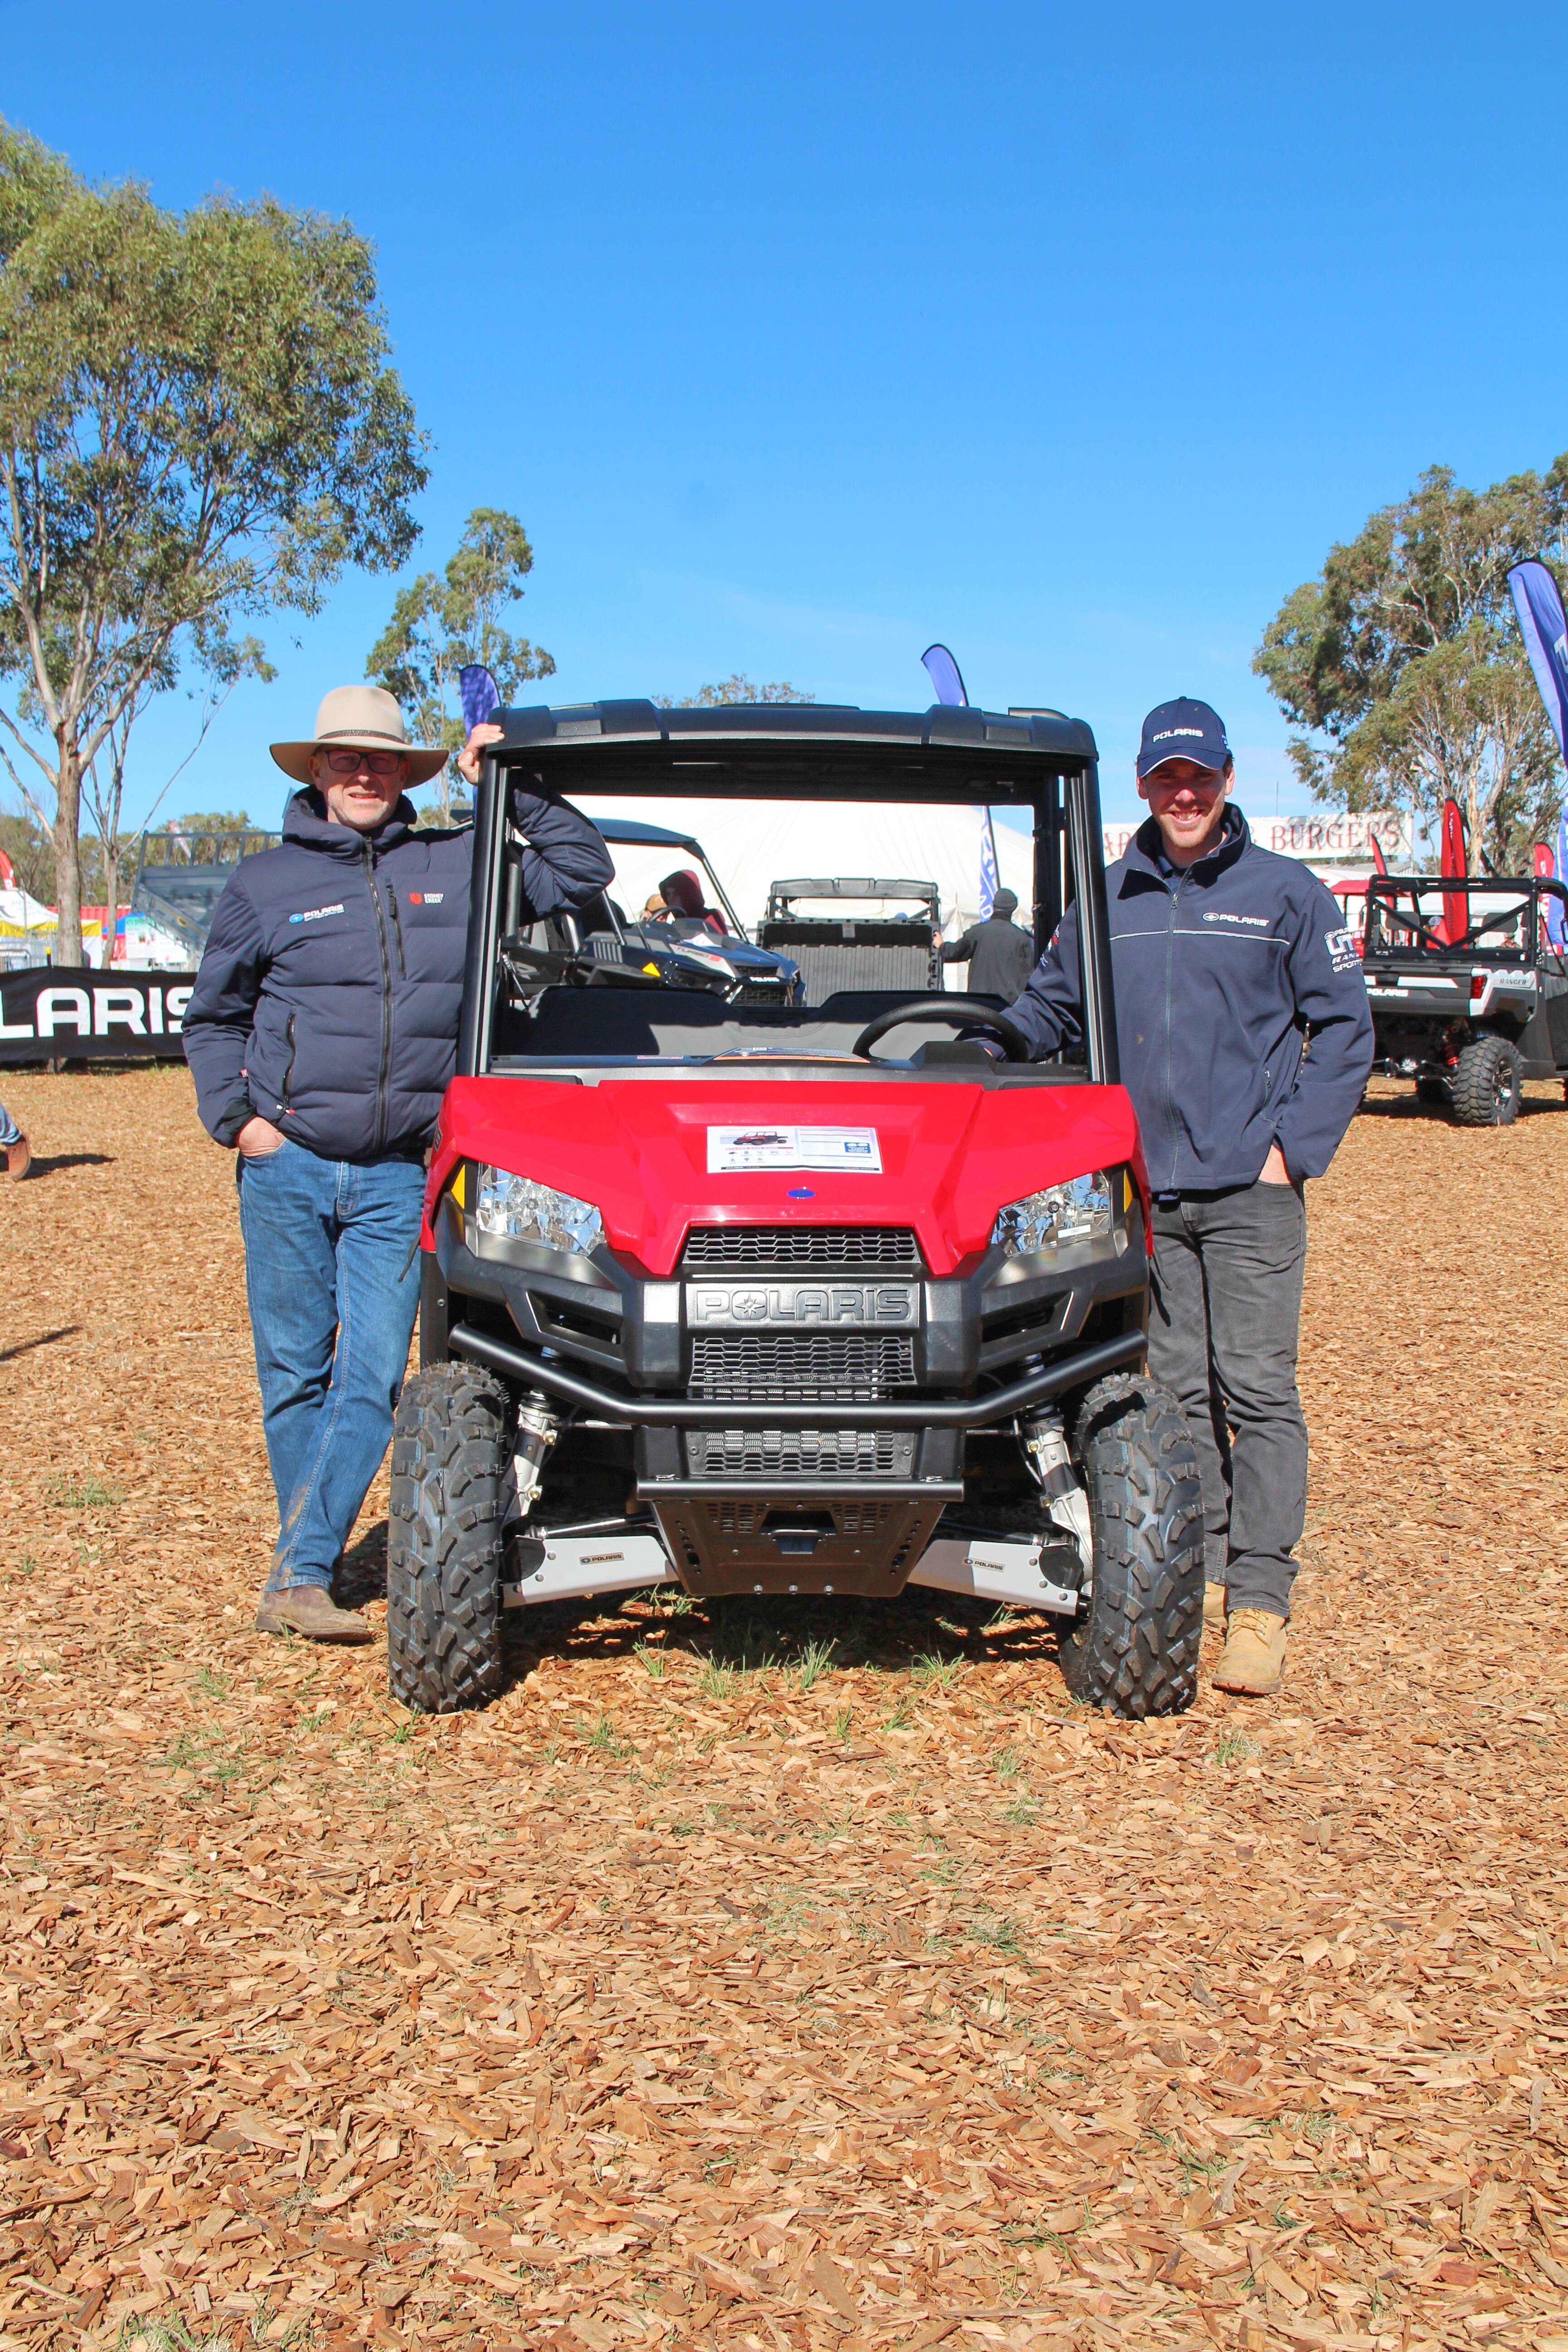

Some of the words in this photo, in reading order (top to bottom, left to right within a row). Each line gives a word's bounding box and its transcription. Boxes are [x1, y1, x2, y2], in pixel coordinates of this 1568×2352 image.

[1153, 728, 1204, 743] POLARIS
[1270, 820, 1399, 851] BURGERS
[304, 903, 344, 919] POLARIS
[1219, 914, 1270, 927] POLARIS
[697, 1290, 911, 1320] POLARIS
[975, 1560, 1003, 1570] POLARIS
